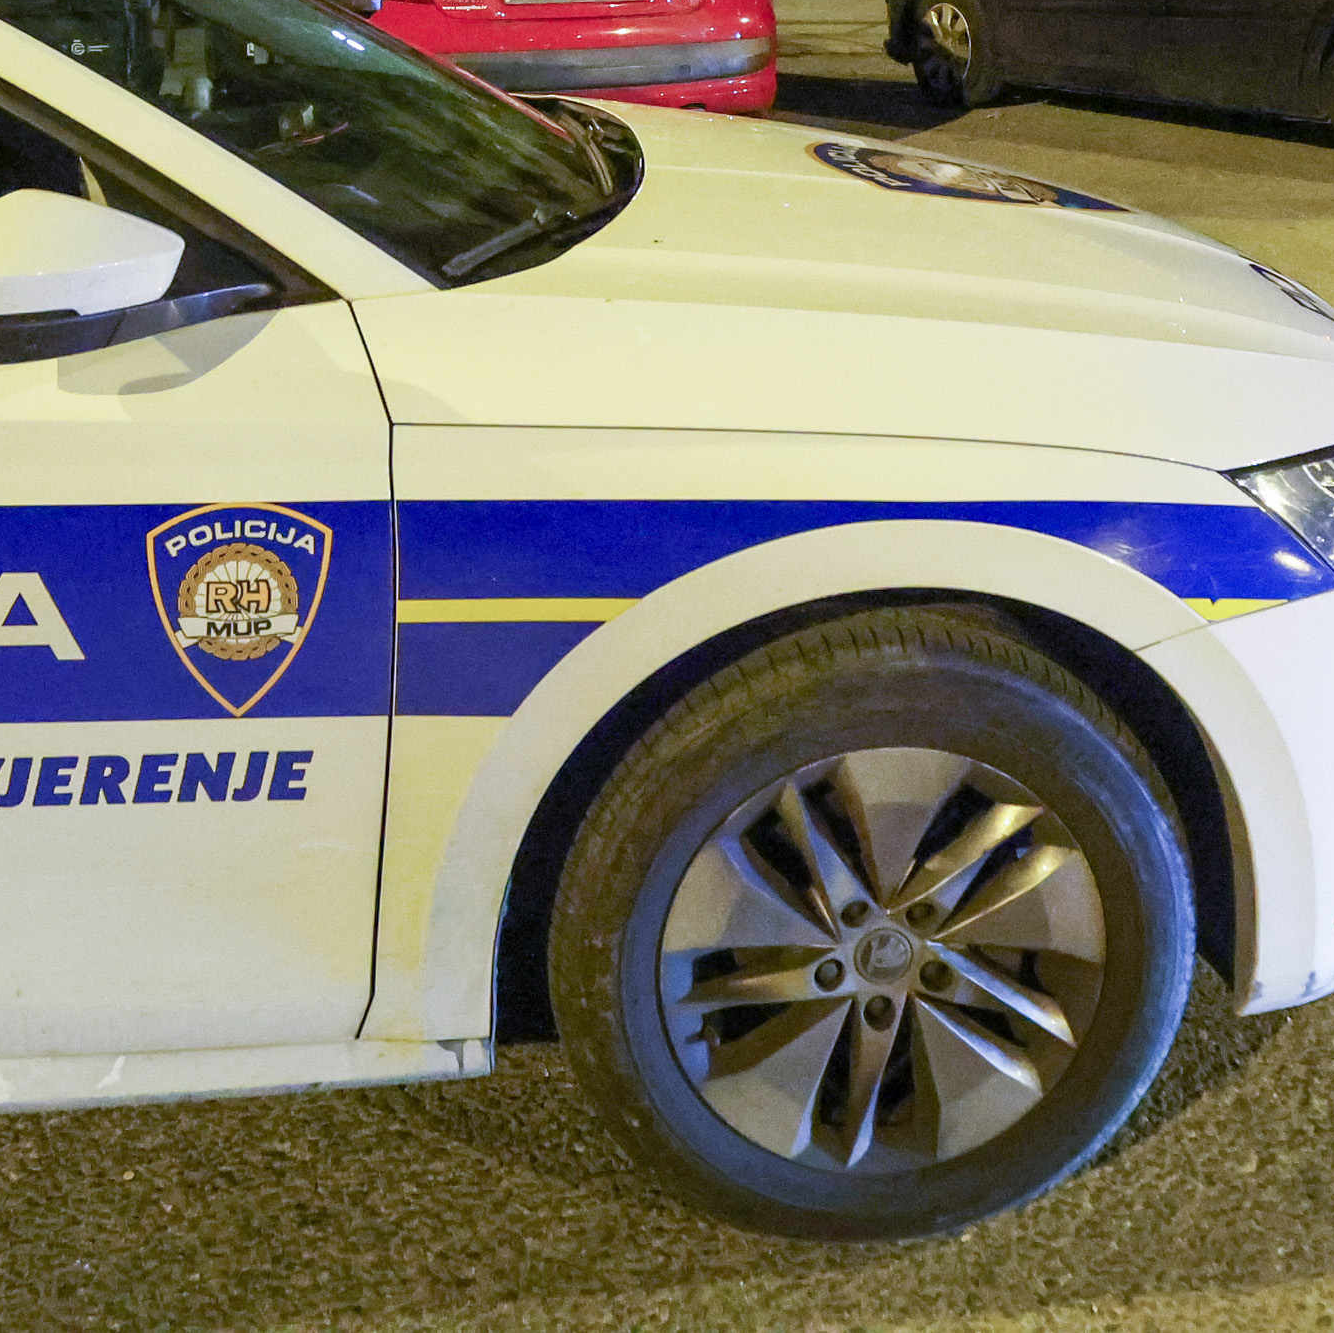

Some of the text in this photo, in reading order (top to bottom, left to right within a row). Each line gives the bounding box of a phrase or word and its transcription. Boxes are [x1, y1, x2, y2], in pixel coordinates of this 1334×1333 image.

[165, 520, 315, 558] POLICIJA
[205, 579, 272, 614] RH
[206, 619, 273, 638] MUP
